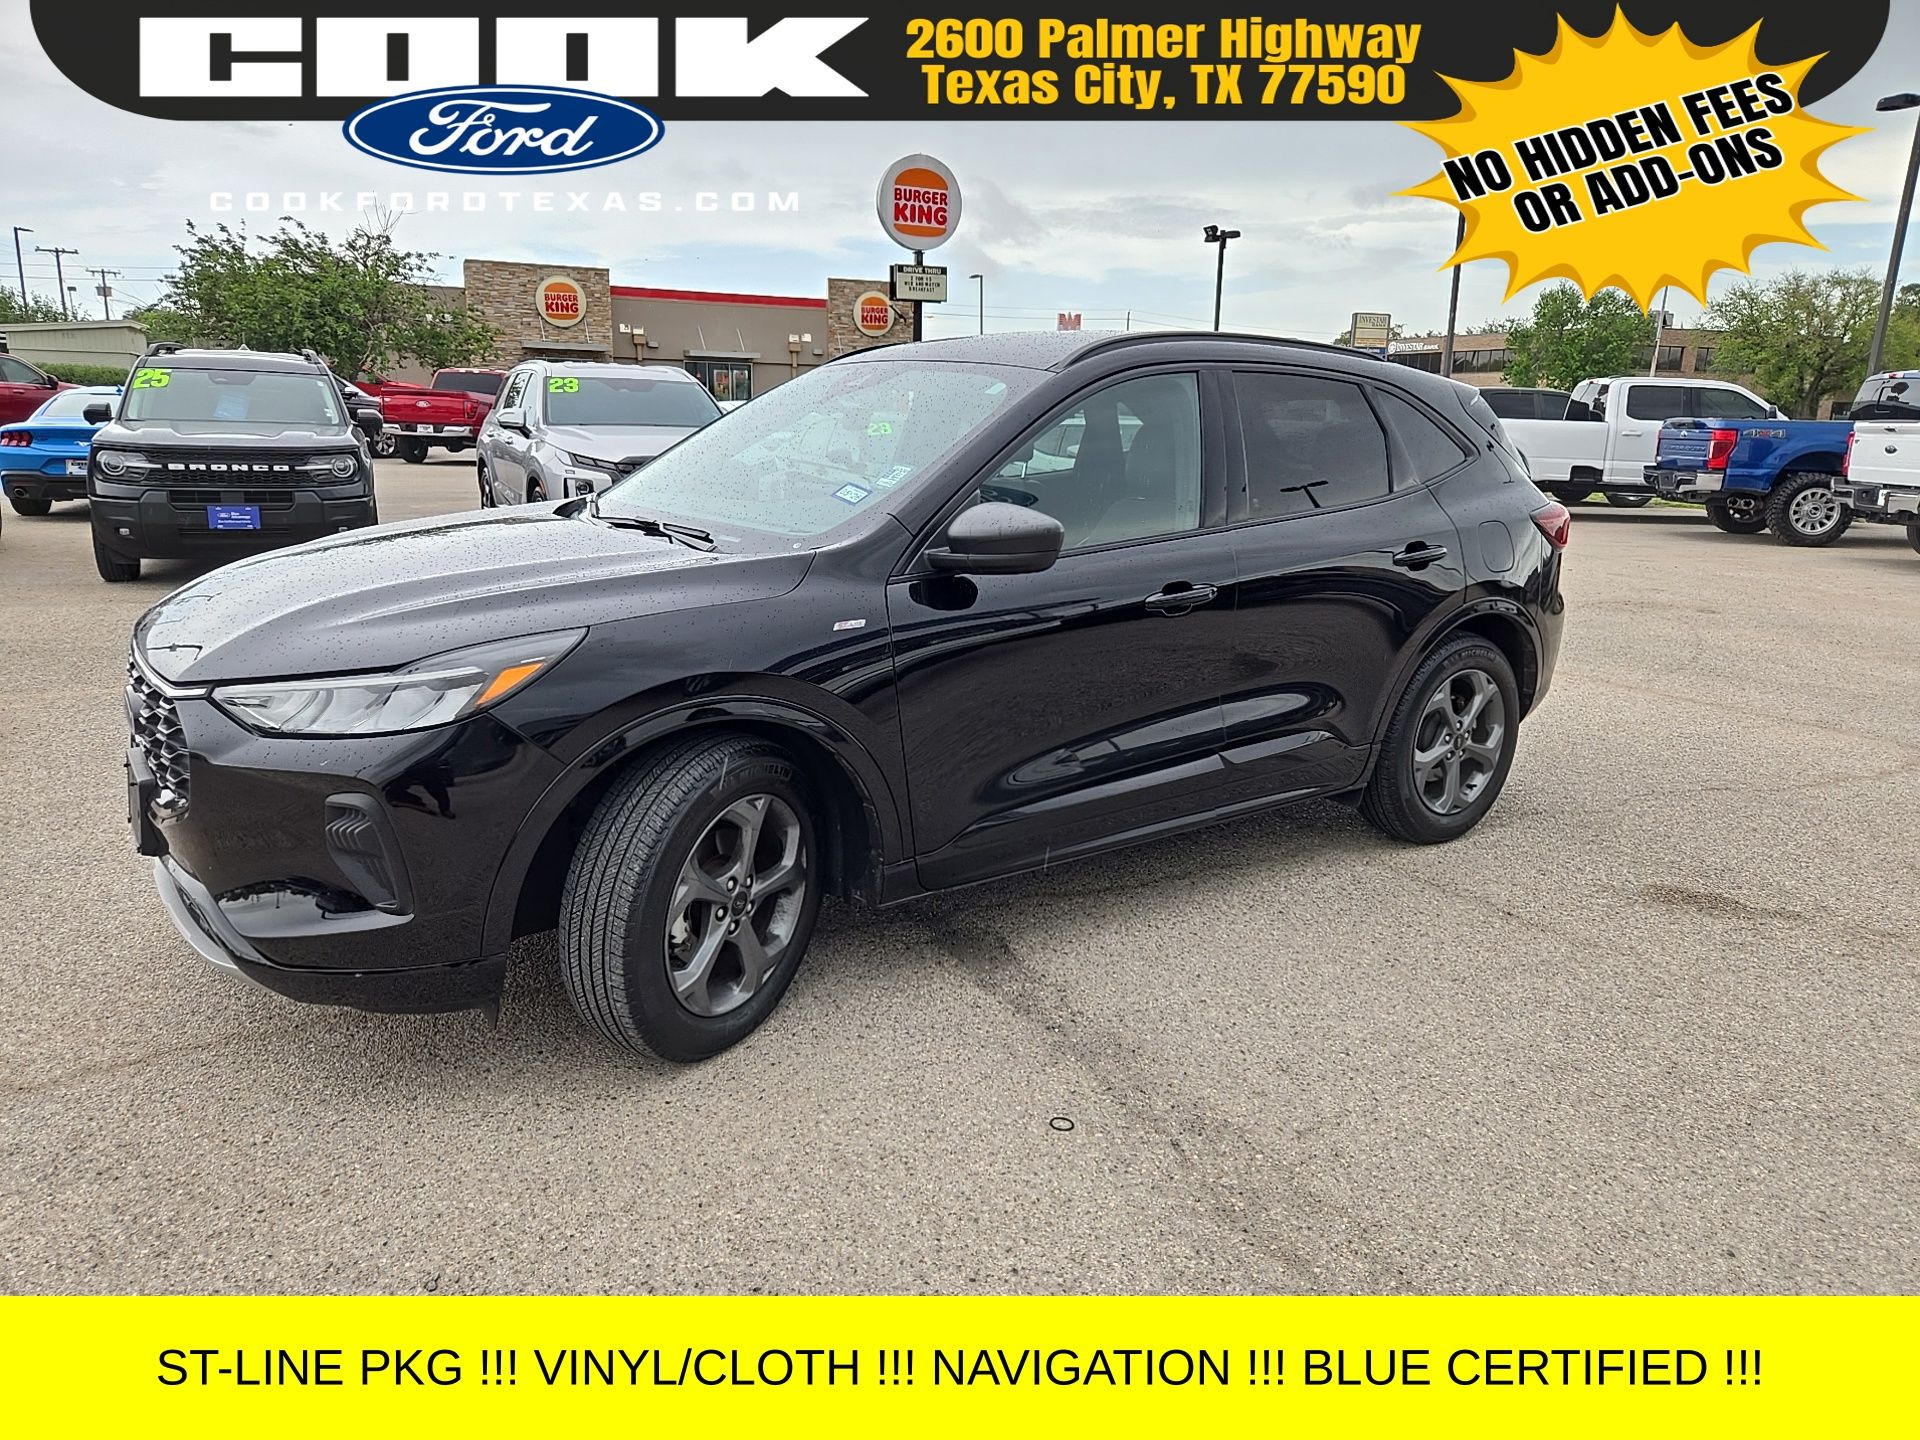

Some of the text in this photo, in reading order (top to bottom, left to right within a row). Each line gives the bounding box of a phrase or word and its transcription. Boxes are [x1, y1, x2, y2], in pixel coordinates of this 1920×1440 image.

[894, 187, 948, 206] BURGER
[894, 202, 948, 226] KING
[903, 266, 942, 275] DRIVE THRU
[544, 293, 579, 302] BURGER
[545, 301, 579, 313] KING
[861, 306, 888, 315] BURGER
[861, 314, 889, 325] KING
[133, 369, 171, 389] 25
[549, 377, 579, 392] 23
[167, 462, 290, 472] BRONCO
